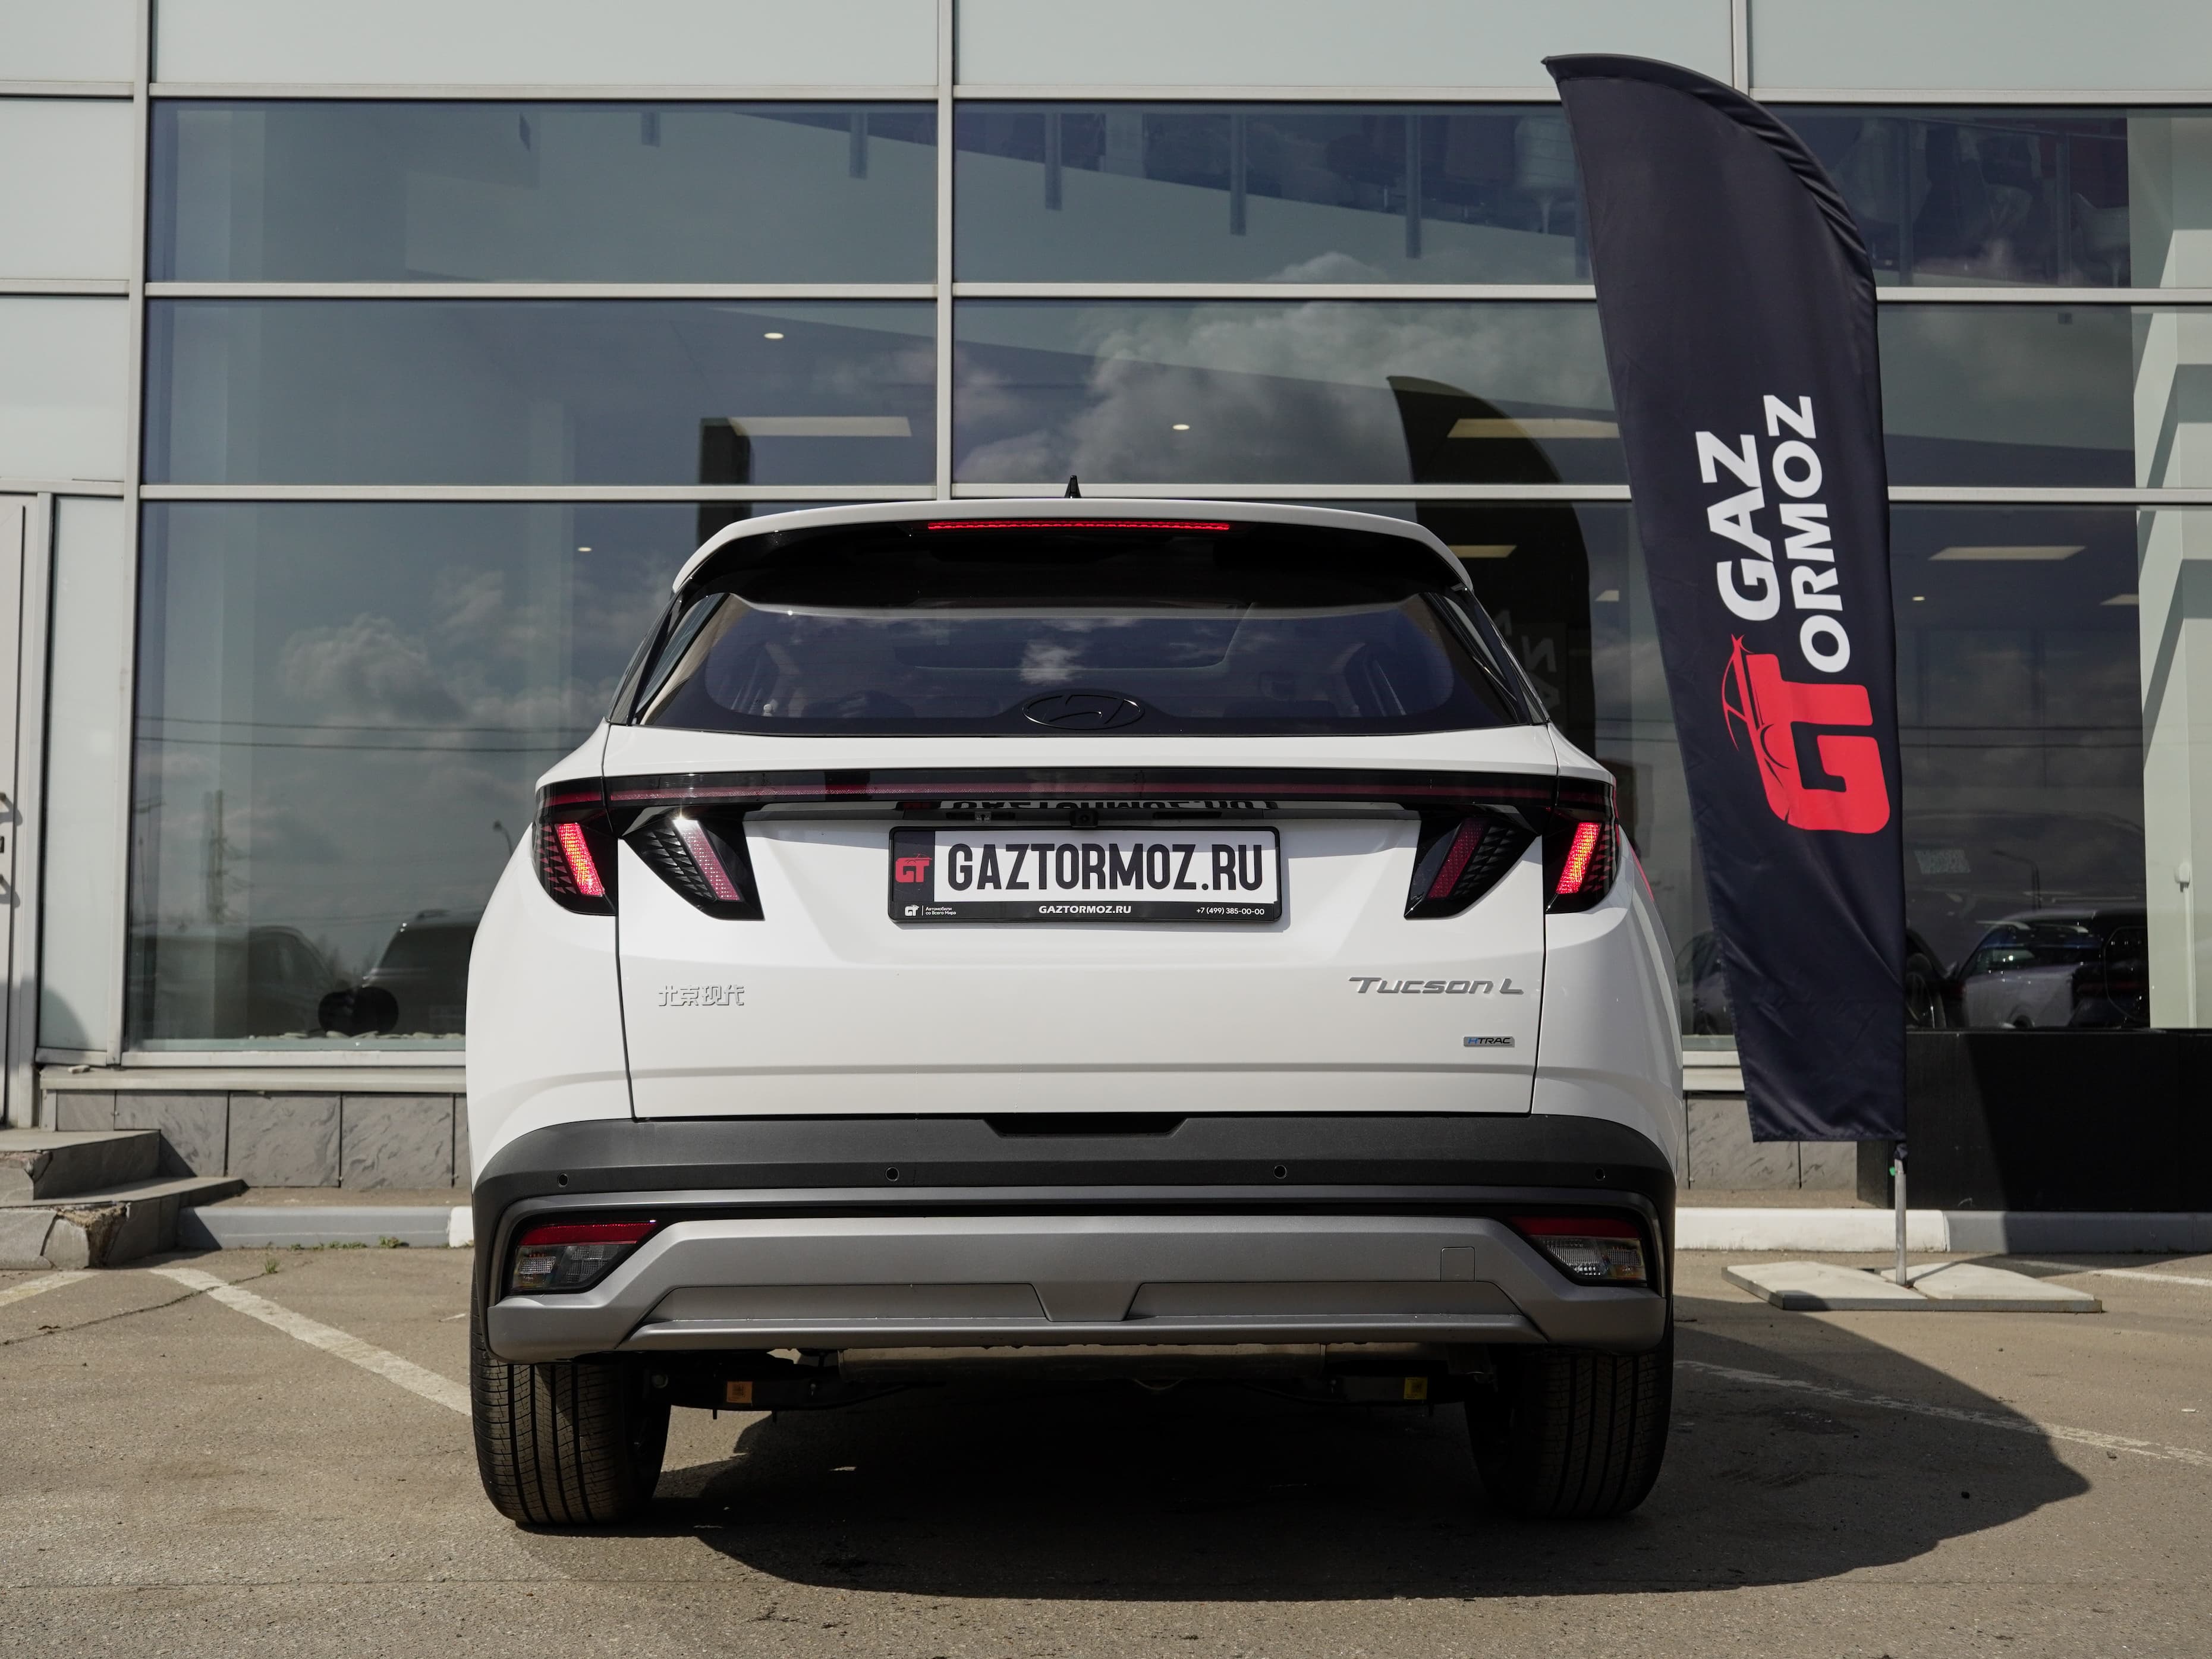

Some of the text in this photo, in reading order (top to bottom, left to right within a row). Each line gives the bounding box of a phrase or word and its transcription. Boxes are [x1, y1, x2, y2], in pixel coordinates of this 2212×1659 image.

[1695, 431, 1780, 621] GAZ
[1763, 395, 1851, 673] ORMOZ
[948, 843, 1263, 891] GAZTORMOZ.RU
[1038, 905, 1132, 914] GAZTORMOZ.RU
[1206, 906, 1225, 915] (499)
[1226, 907, 1265, 915] 385-00-00
[657, 984, 745, 1007] 北京现代
[1499, 978, 1524, 995] L
